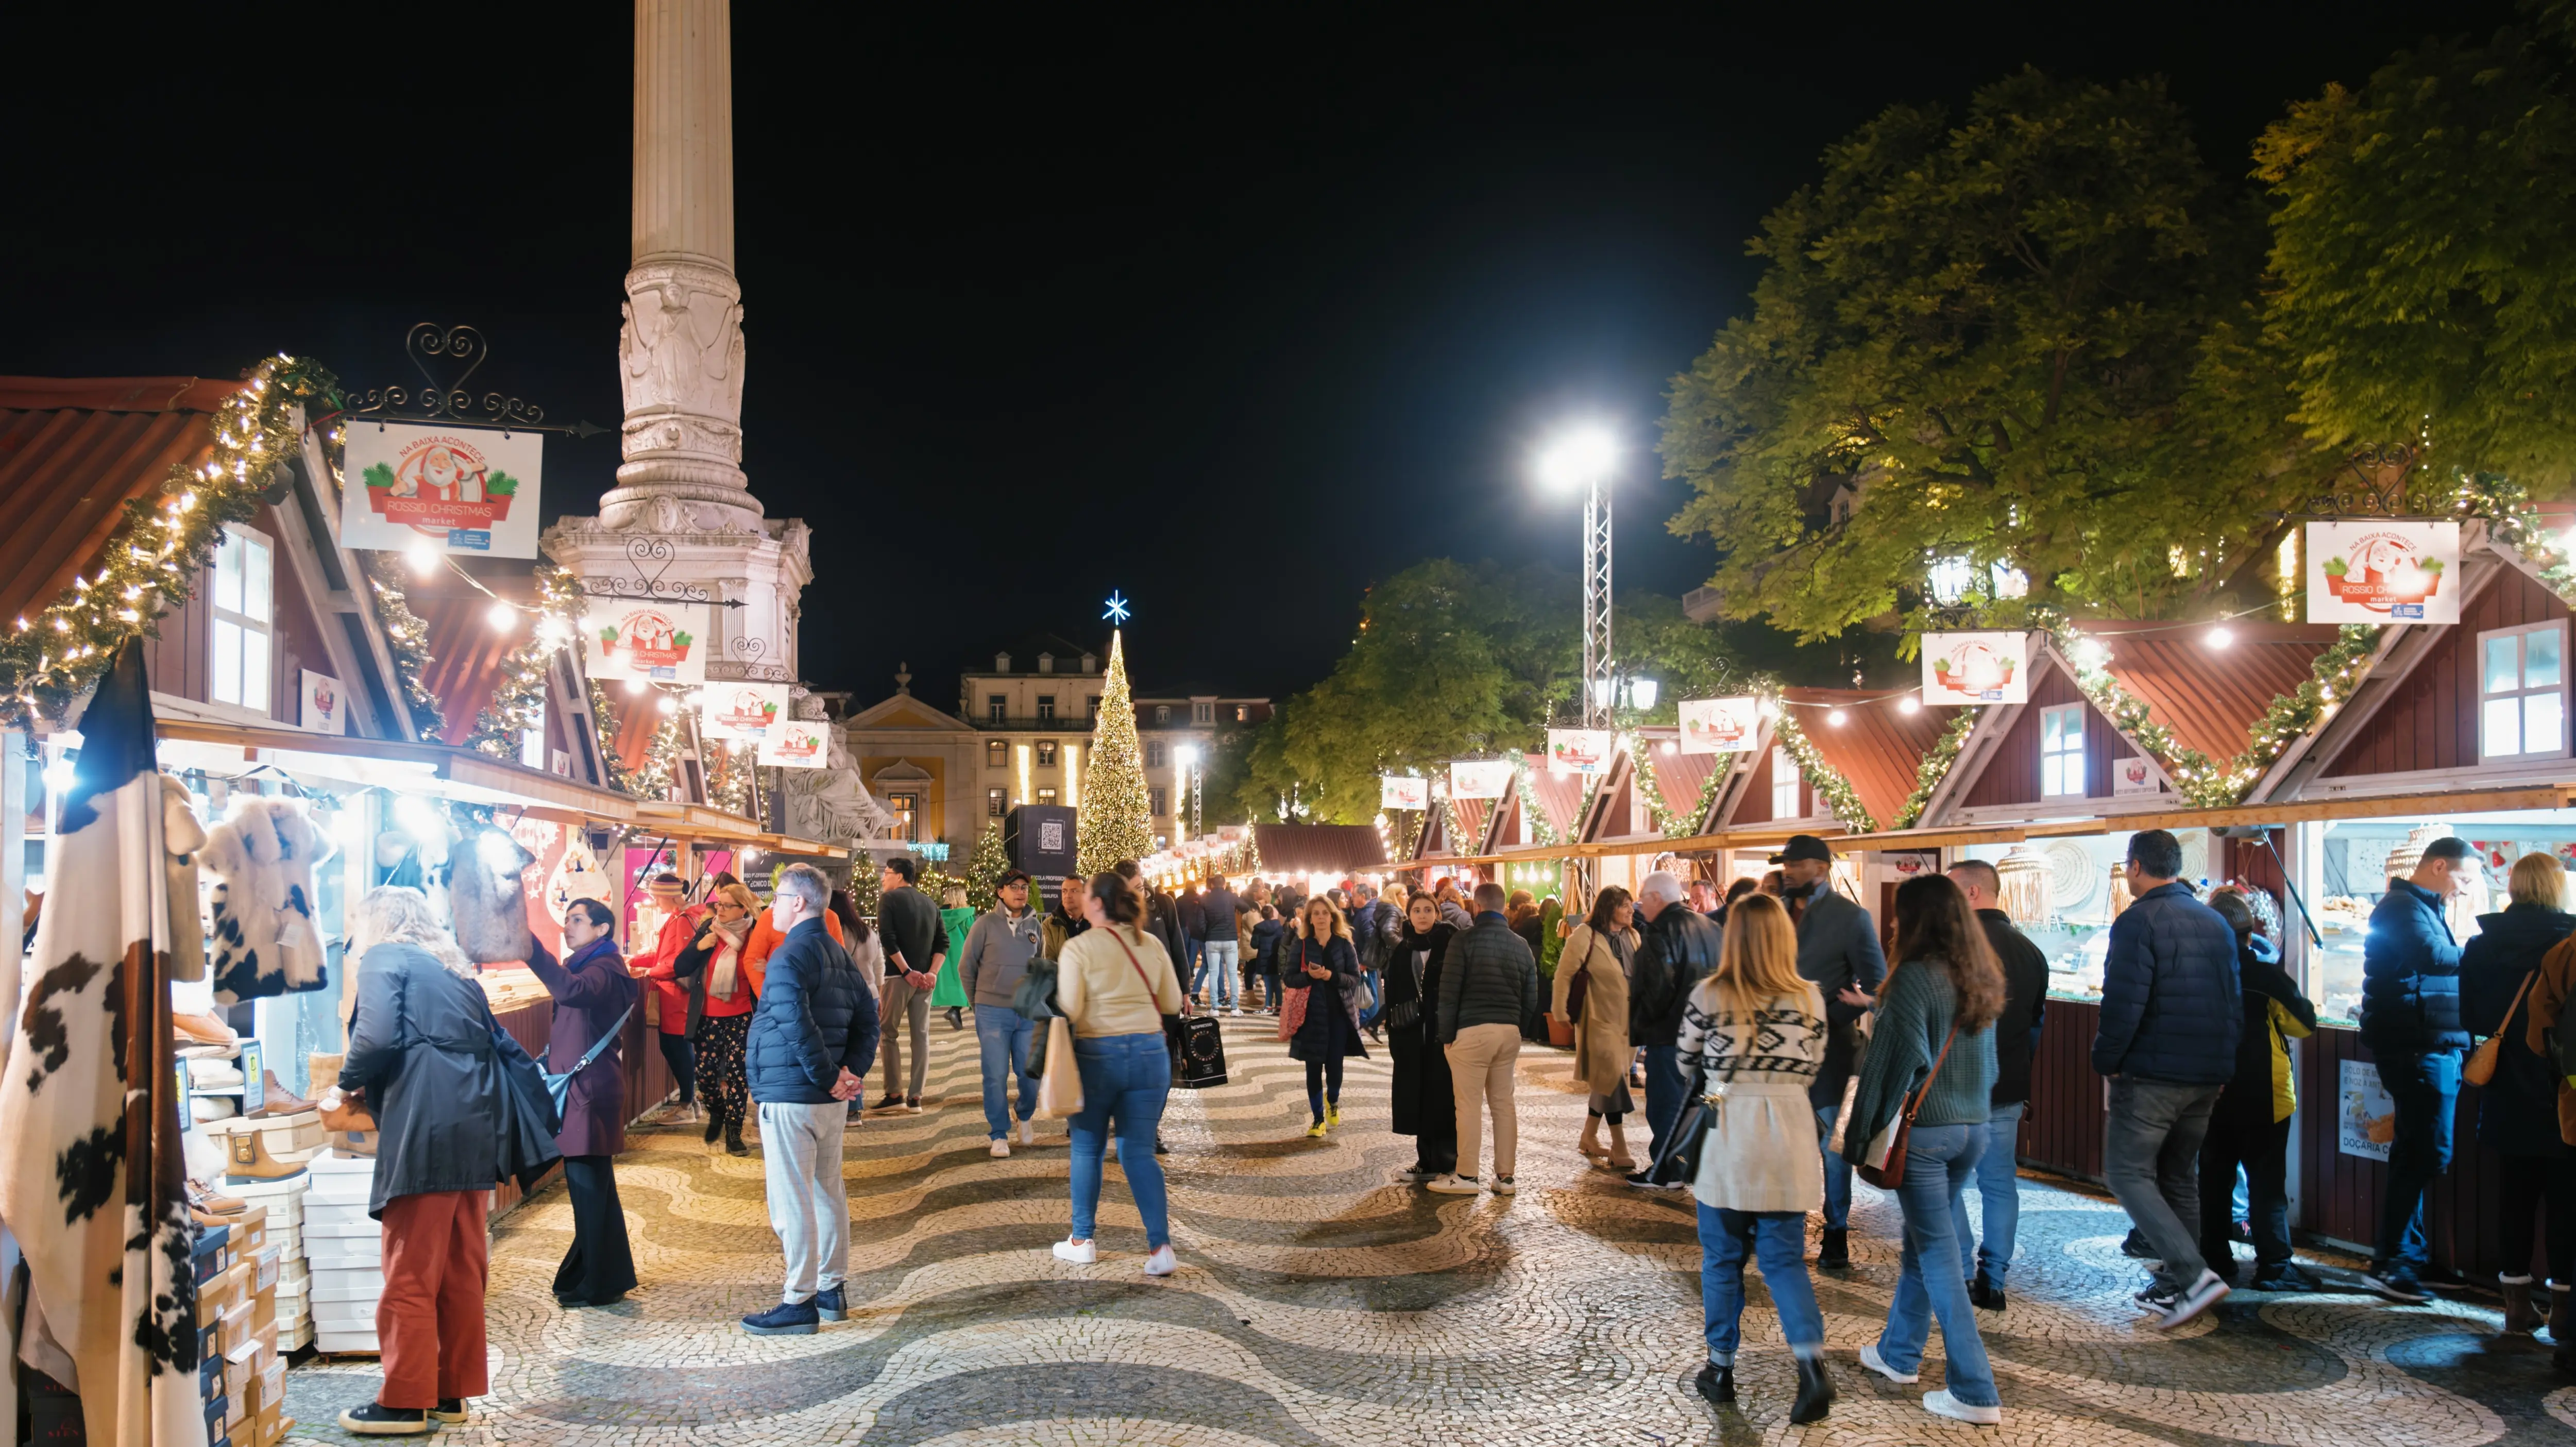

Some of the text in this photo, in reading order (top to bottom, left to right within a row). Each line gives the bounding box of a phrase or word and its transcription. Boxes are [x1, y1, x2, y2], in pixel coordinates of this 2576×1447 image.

[399, 435, 486, 463] NA BAIXA ACONTECE
[387, 500, 492, 517] ROSSIO CHRISTMAS
[422, 516, 456, 526] market
[2349, 532, 2417, 552] NA BAIXA ACONTECE
[2342, 585, 2374, 594] ROSSIO
[629, 609, 646, 617] BAIXA
[647, 609, 674, 626] ACONTECE
[639, 651, 677, 660] CHRISTMAS
[2344, 1066, 2361, 1075] BOLO
[2343, 1137, 2391, 1154] DOÇARIA C
